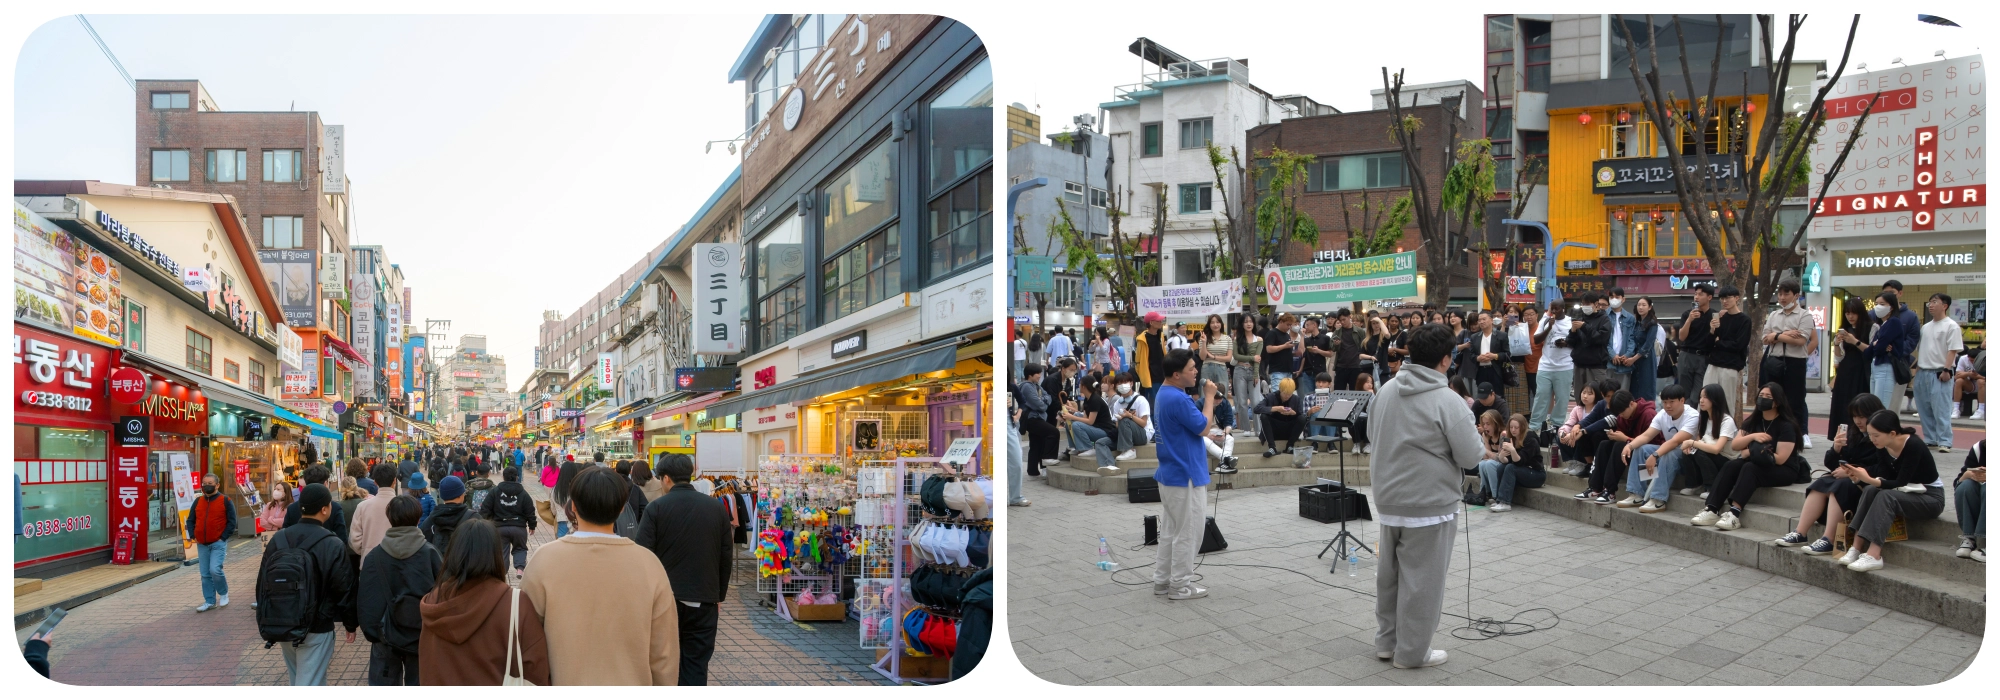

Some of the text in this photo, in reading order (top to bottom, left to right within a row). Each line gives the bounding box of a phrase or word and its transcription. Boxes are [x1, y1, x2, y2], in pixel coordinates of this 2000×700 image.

[1915, 132, 1933, 226] PHOTO
[1522, 247, 1545, 260] 사주
[1847, 253, 1973, 268] PHOTO SIGNATURE
[1335, 262, 1362, 277] 거리공연
[1363, 258, 1394, 275] 준수사항
[1395, 255, 1412, 270] 안내
[709, 273, 728, 341] 三丁目
[1195, 297, 1200, 307] 수
[111, 379, 144, 392] 부동산
[39, 391, 92, 412] 338-8112
[142, 394, 197, 422] MISSHA
[36, 515, 91, 537] 338-8112
